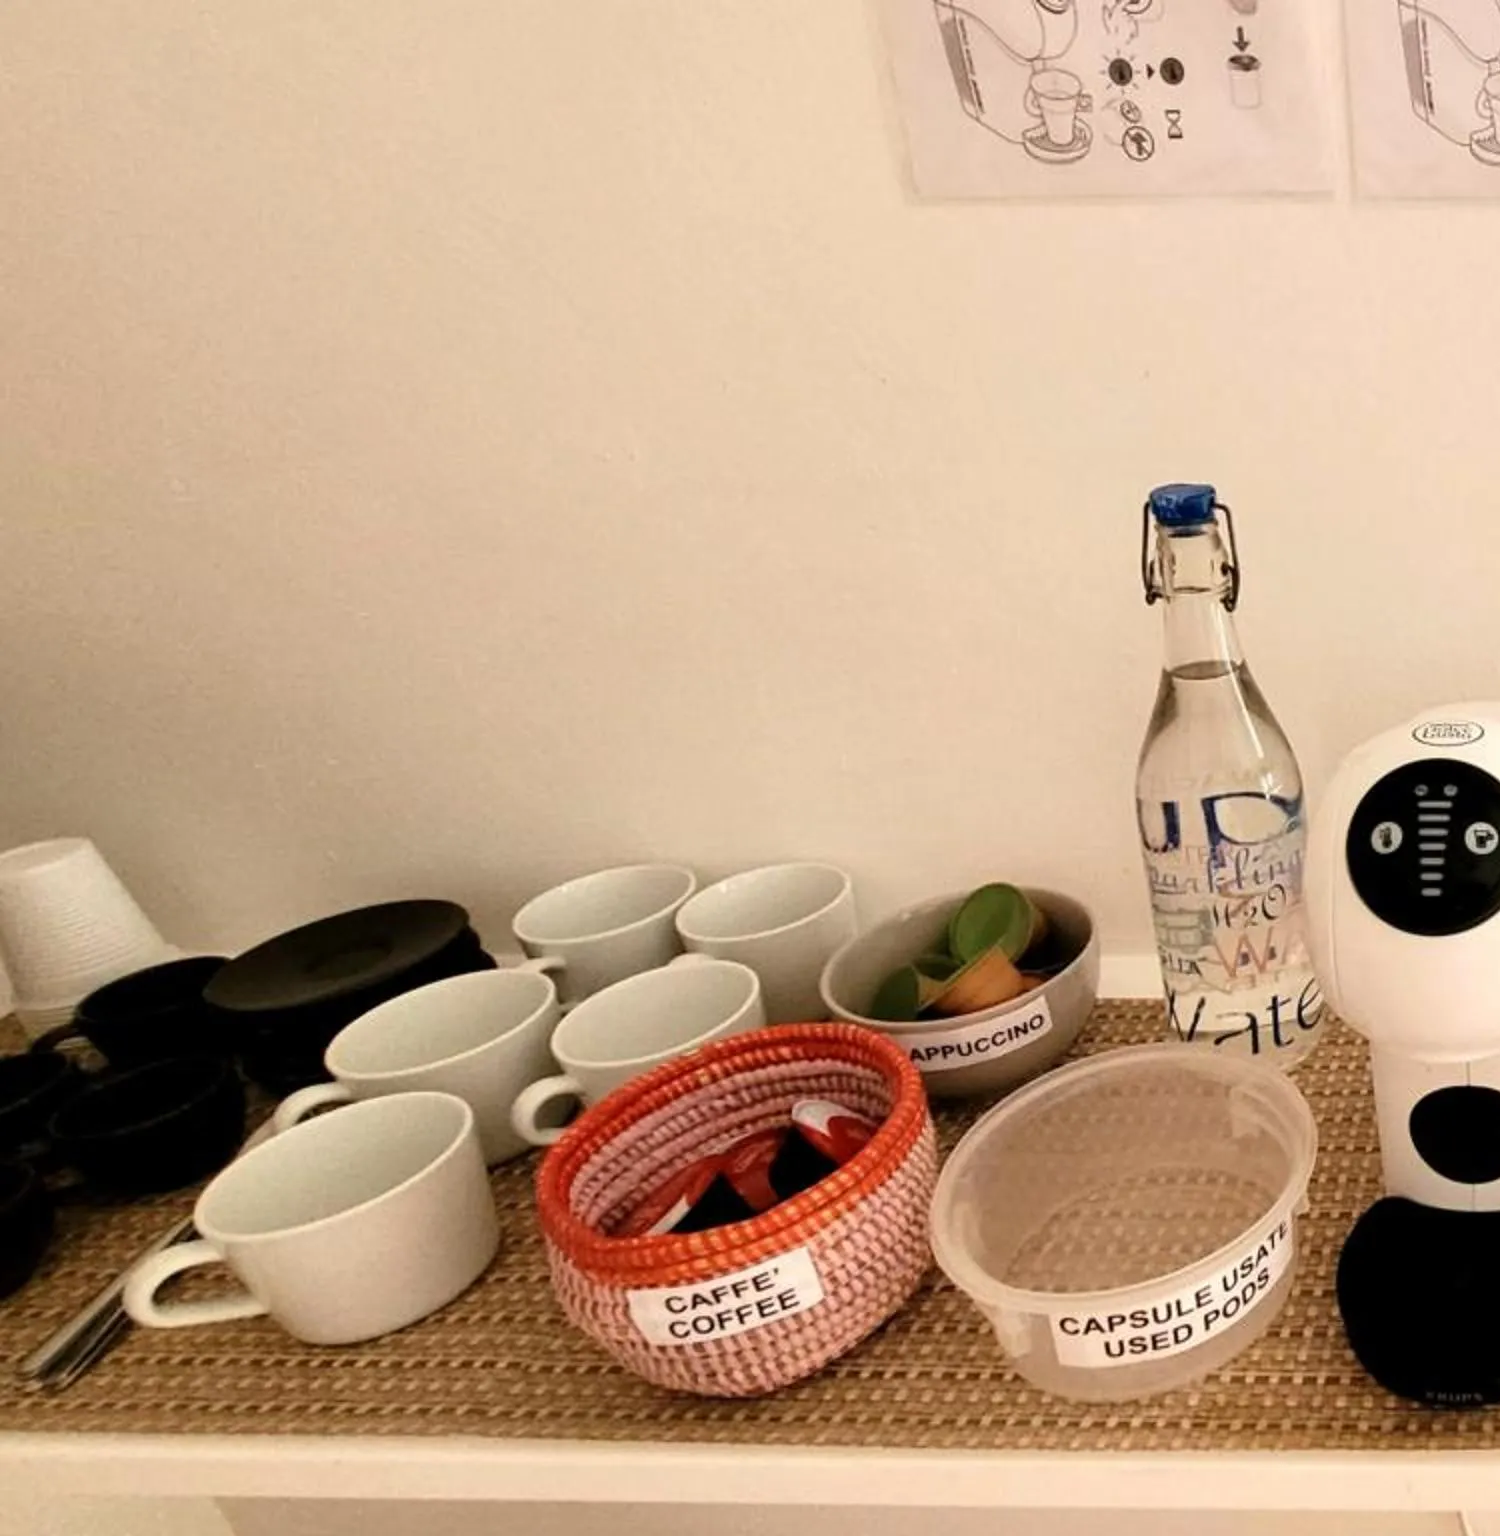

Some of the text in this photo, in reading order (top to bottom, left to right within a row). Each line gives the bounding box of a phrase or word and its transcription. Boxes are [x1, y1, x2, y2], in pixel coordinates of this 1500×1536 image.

[909, 1013, 1045, 1062] APPUCCINO
[664, 1267, 779, 1314] CAFFE'
[1059, 1220, 1288, 1335] CAPSULE USATE
[668, 1287, 801, 1339] COFFEE
[1104, 1267, 1270, 1358] USED PODS
